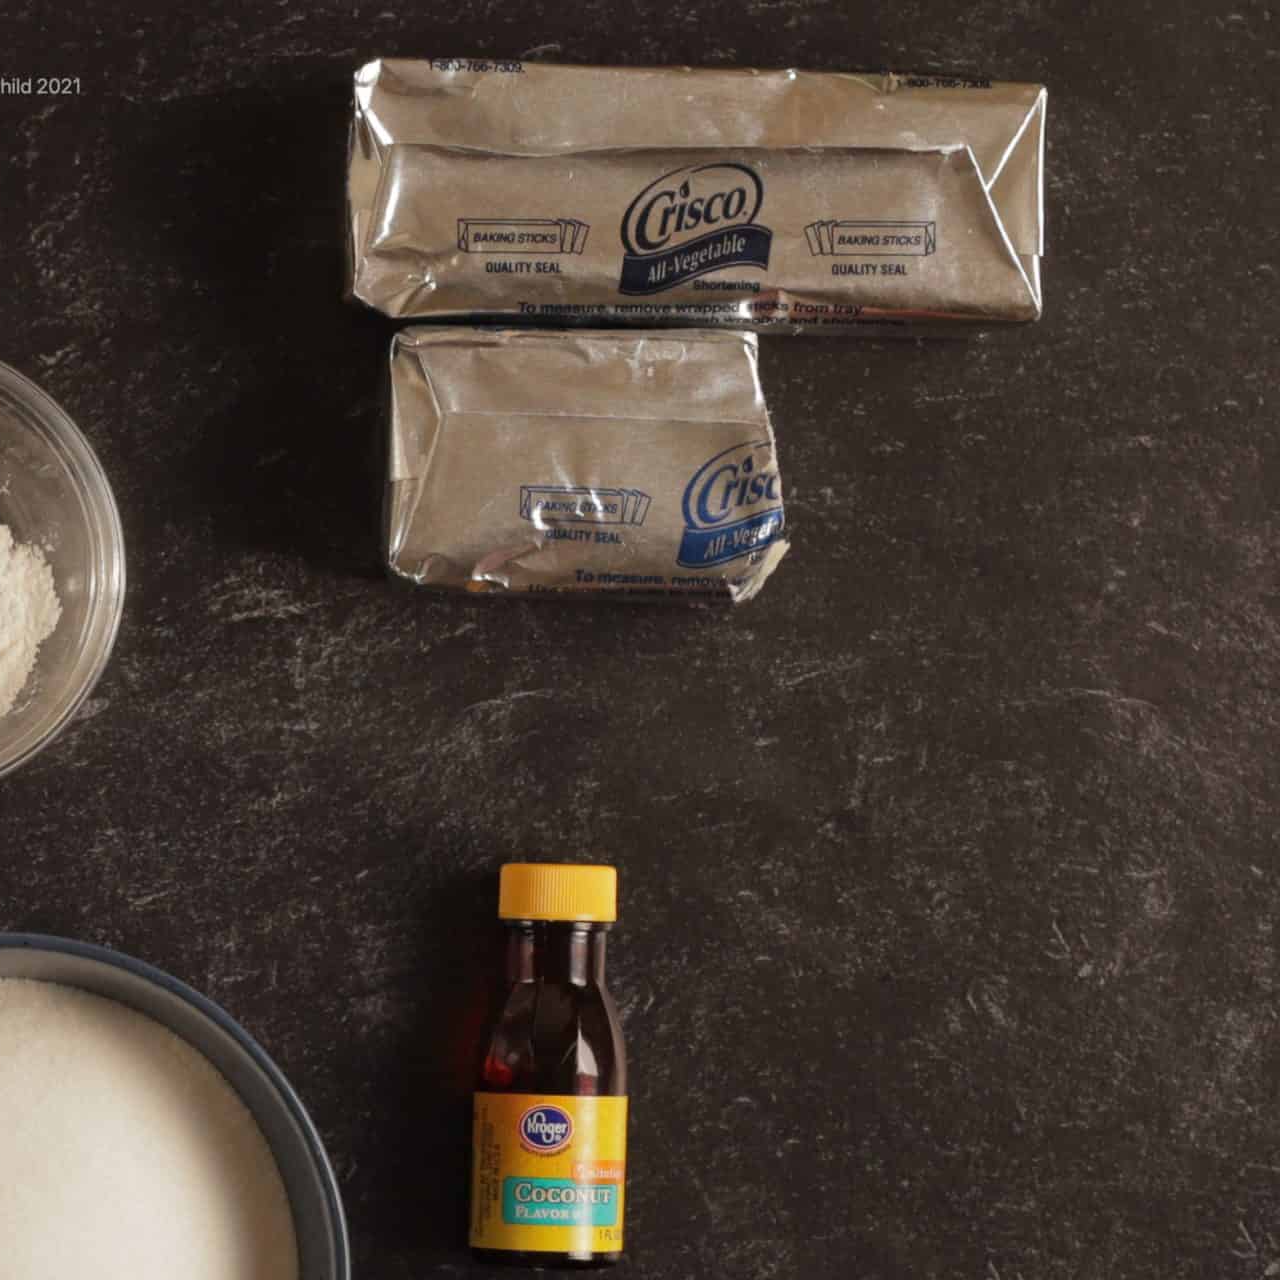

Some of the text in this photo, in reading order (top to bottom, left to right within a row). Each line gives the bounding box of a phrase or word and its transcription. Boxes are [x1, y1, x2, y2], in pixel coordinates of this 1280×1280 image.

[635, 180, 747, 251] Crisco
[473, 232, 558, 244] BAKING STICKS
[838, 235, 921, 246] BAKING STICKS
[647, 233, 746, 284] All-Vegetable
[485, 261, 562, 273] QUALITY SEAL
[831, 263, 908, 275] QUALITY SEAL
[693, 279, 760, 292] Shortening
[793, 302, 830, 313] from
[545, 529, 592, 540] QUALITY
[527, 1111, 568, 1144] Kroger
